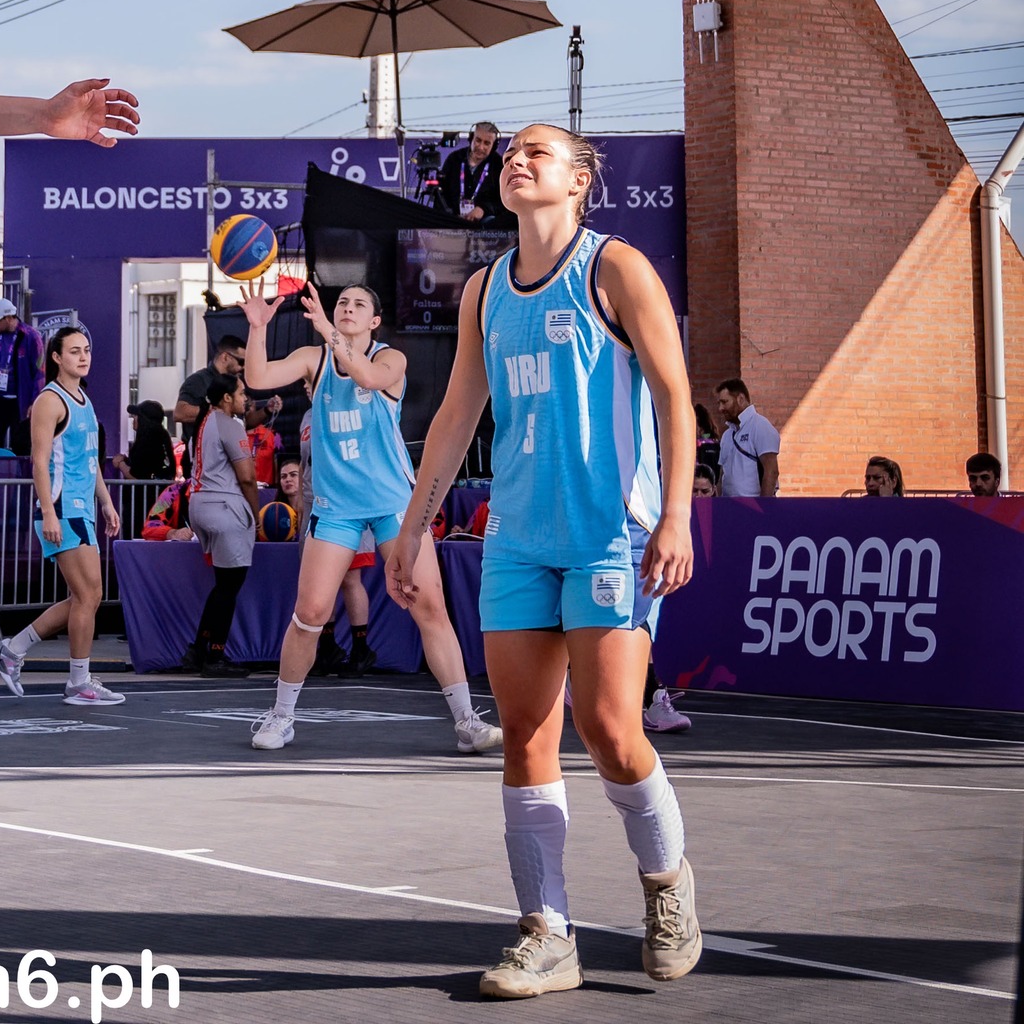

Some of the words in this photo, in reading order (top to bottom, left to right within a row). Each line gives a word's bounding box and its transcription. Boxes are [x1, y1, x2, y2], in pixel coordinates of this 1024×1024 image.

[43, 187, 232, 210] BALONCESTO
[240, 188, 288, 210] 3x3
[588, 186, 616, 208] LL
[627, 186, 674, 208] 3x3
[419, 268, 436, 295] 0
[413, 300, 442, 308] Faltas
[423, 311, 432, 323] 0
[504, 351, 551, 398] URU
[329, 409, 363, 433] URU
[339, 438, 360, 461] 12
[421, 477, 439, 527] PATIENCE
[749, 535, 941, 598] PANAM
[741, 597, 937, 663] SPORTS
